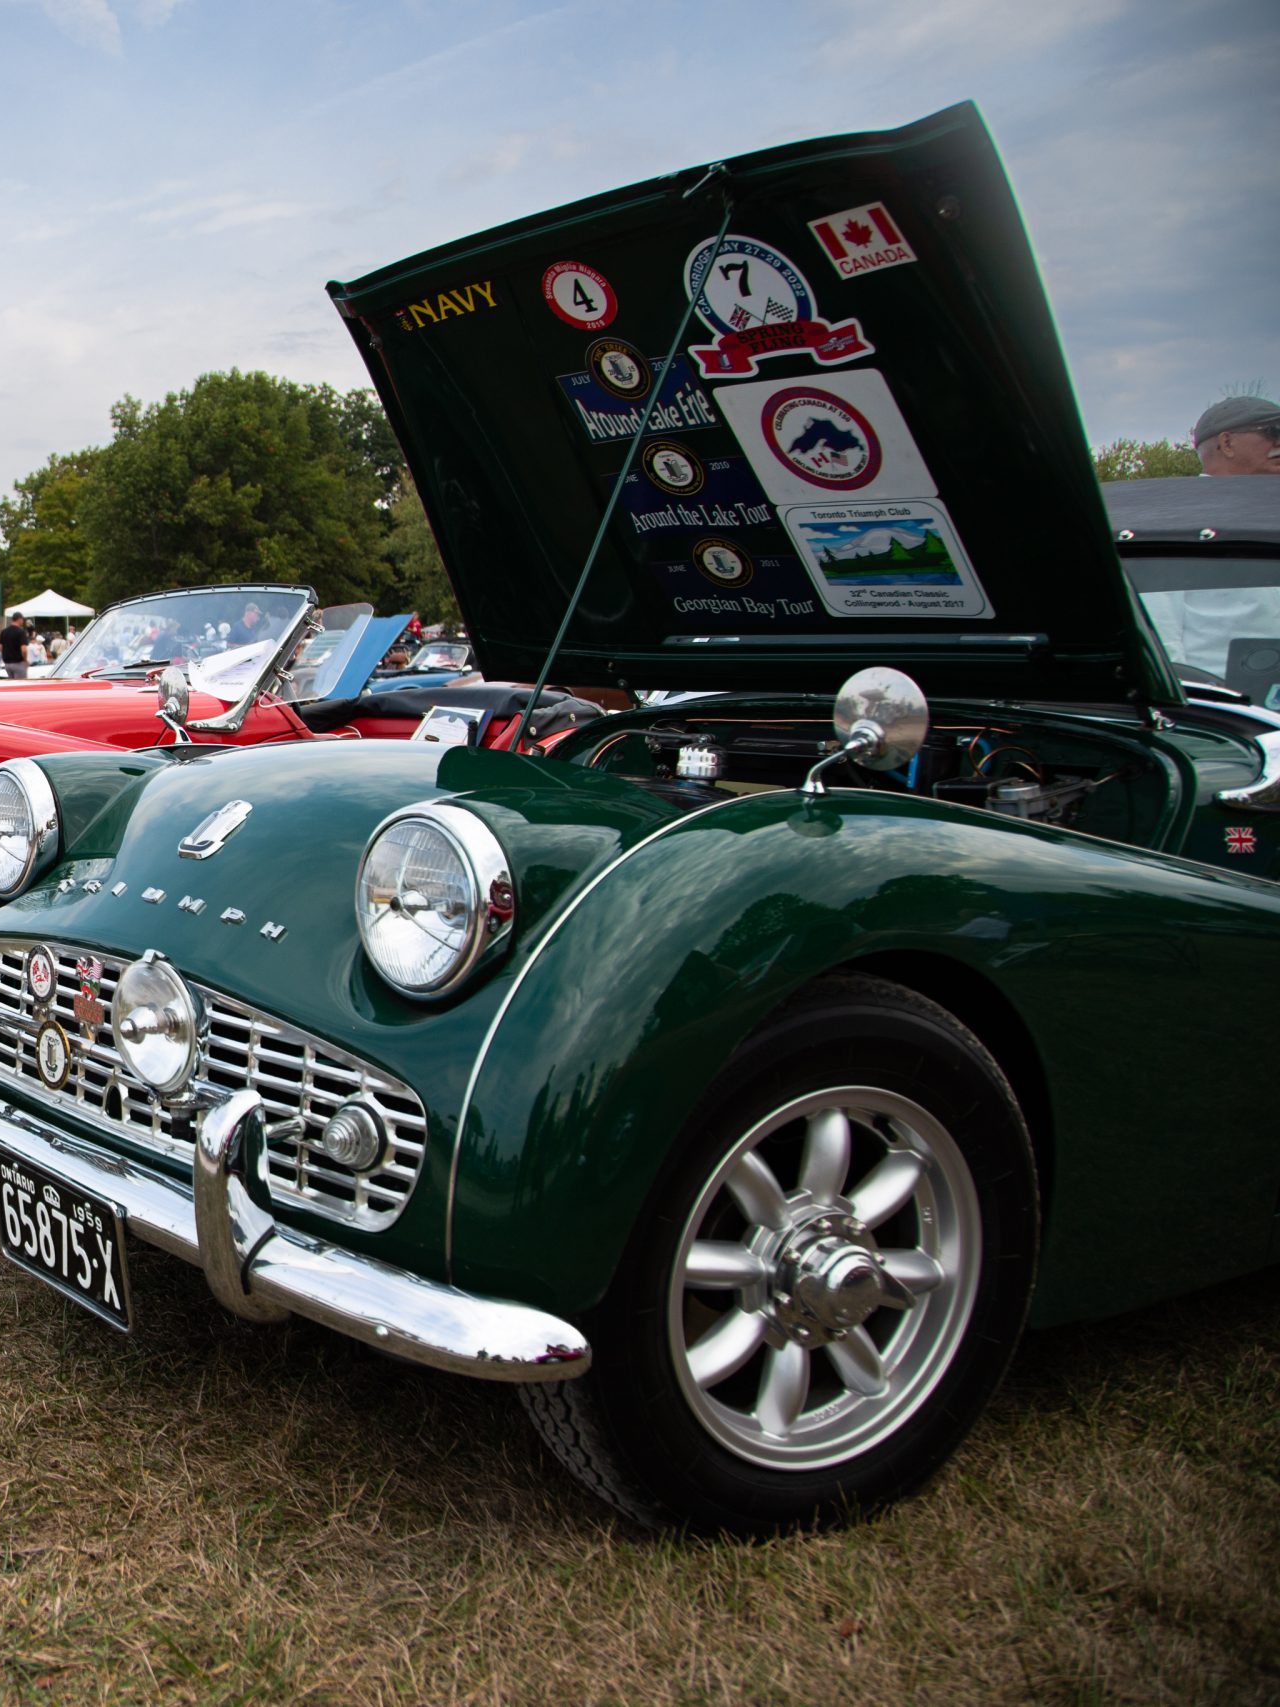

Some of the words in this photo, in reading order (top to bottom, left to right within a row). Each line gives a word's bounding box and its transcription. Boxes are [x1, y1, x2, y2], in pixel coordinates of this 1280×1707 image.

[838, 244, 911, 276] CANADA
[578, 263, 607, 288] Niagara
[719, 260, 752, 298] 7
[782, 267, 806, 298] 2022
[407, 280, 498, 328] NAVY
[573, 278, 598, 313] 4
[586, 319, 606, 329] 2019
[736, 322, 805, 344] SPRING
[749, 335, 806, 353] FLING
[571, 372, 592, 386] JULY
[576, 399, 642, 440] Around
[641, 402, 684, 431] Lake
[675, 382, 717, 426] Erie
[708, 461, 730, 471] 2010
[630, 504, 676, 533] Around
[677, 503, 703, 526] the
[698, 503, 740, 526] Lake
[734, 502, 773, 526] Tour
[811, 510, 847, 520] Toronto
[847, 508, 888, 519] Triumph
[888, 507, 911, 516] Club
[673, 594, 742, 614] Georgian
[742, 596, 776, 618] Bay
[776, 599, 815, 616] Tour
[844, 599, 901, 609] Collingwood
[908, 599, 942, 609] August
[869, 589, 912, 598] Canadian
[913, 589, 950, 598] Classic
[57, 878, 288, 943] TRIUMPH
[0, 1163, 36, 1195] ONTARIO
[73, 1203, 103, 1232] 1959
